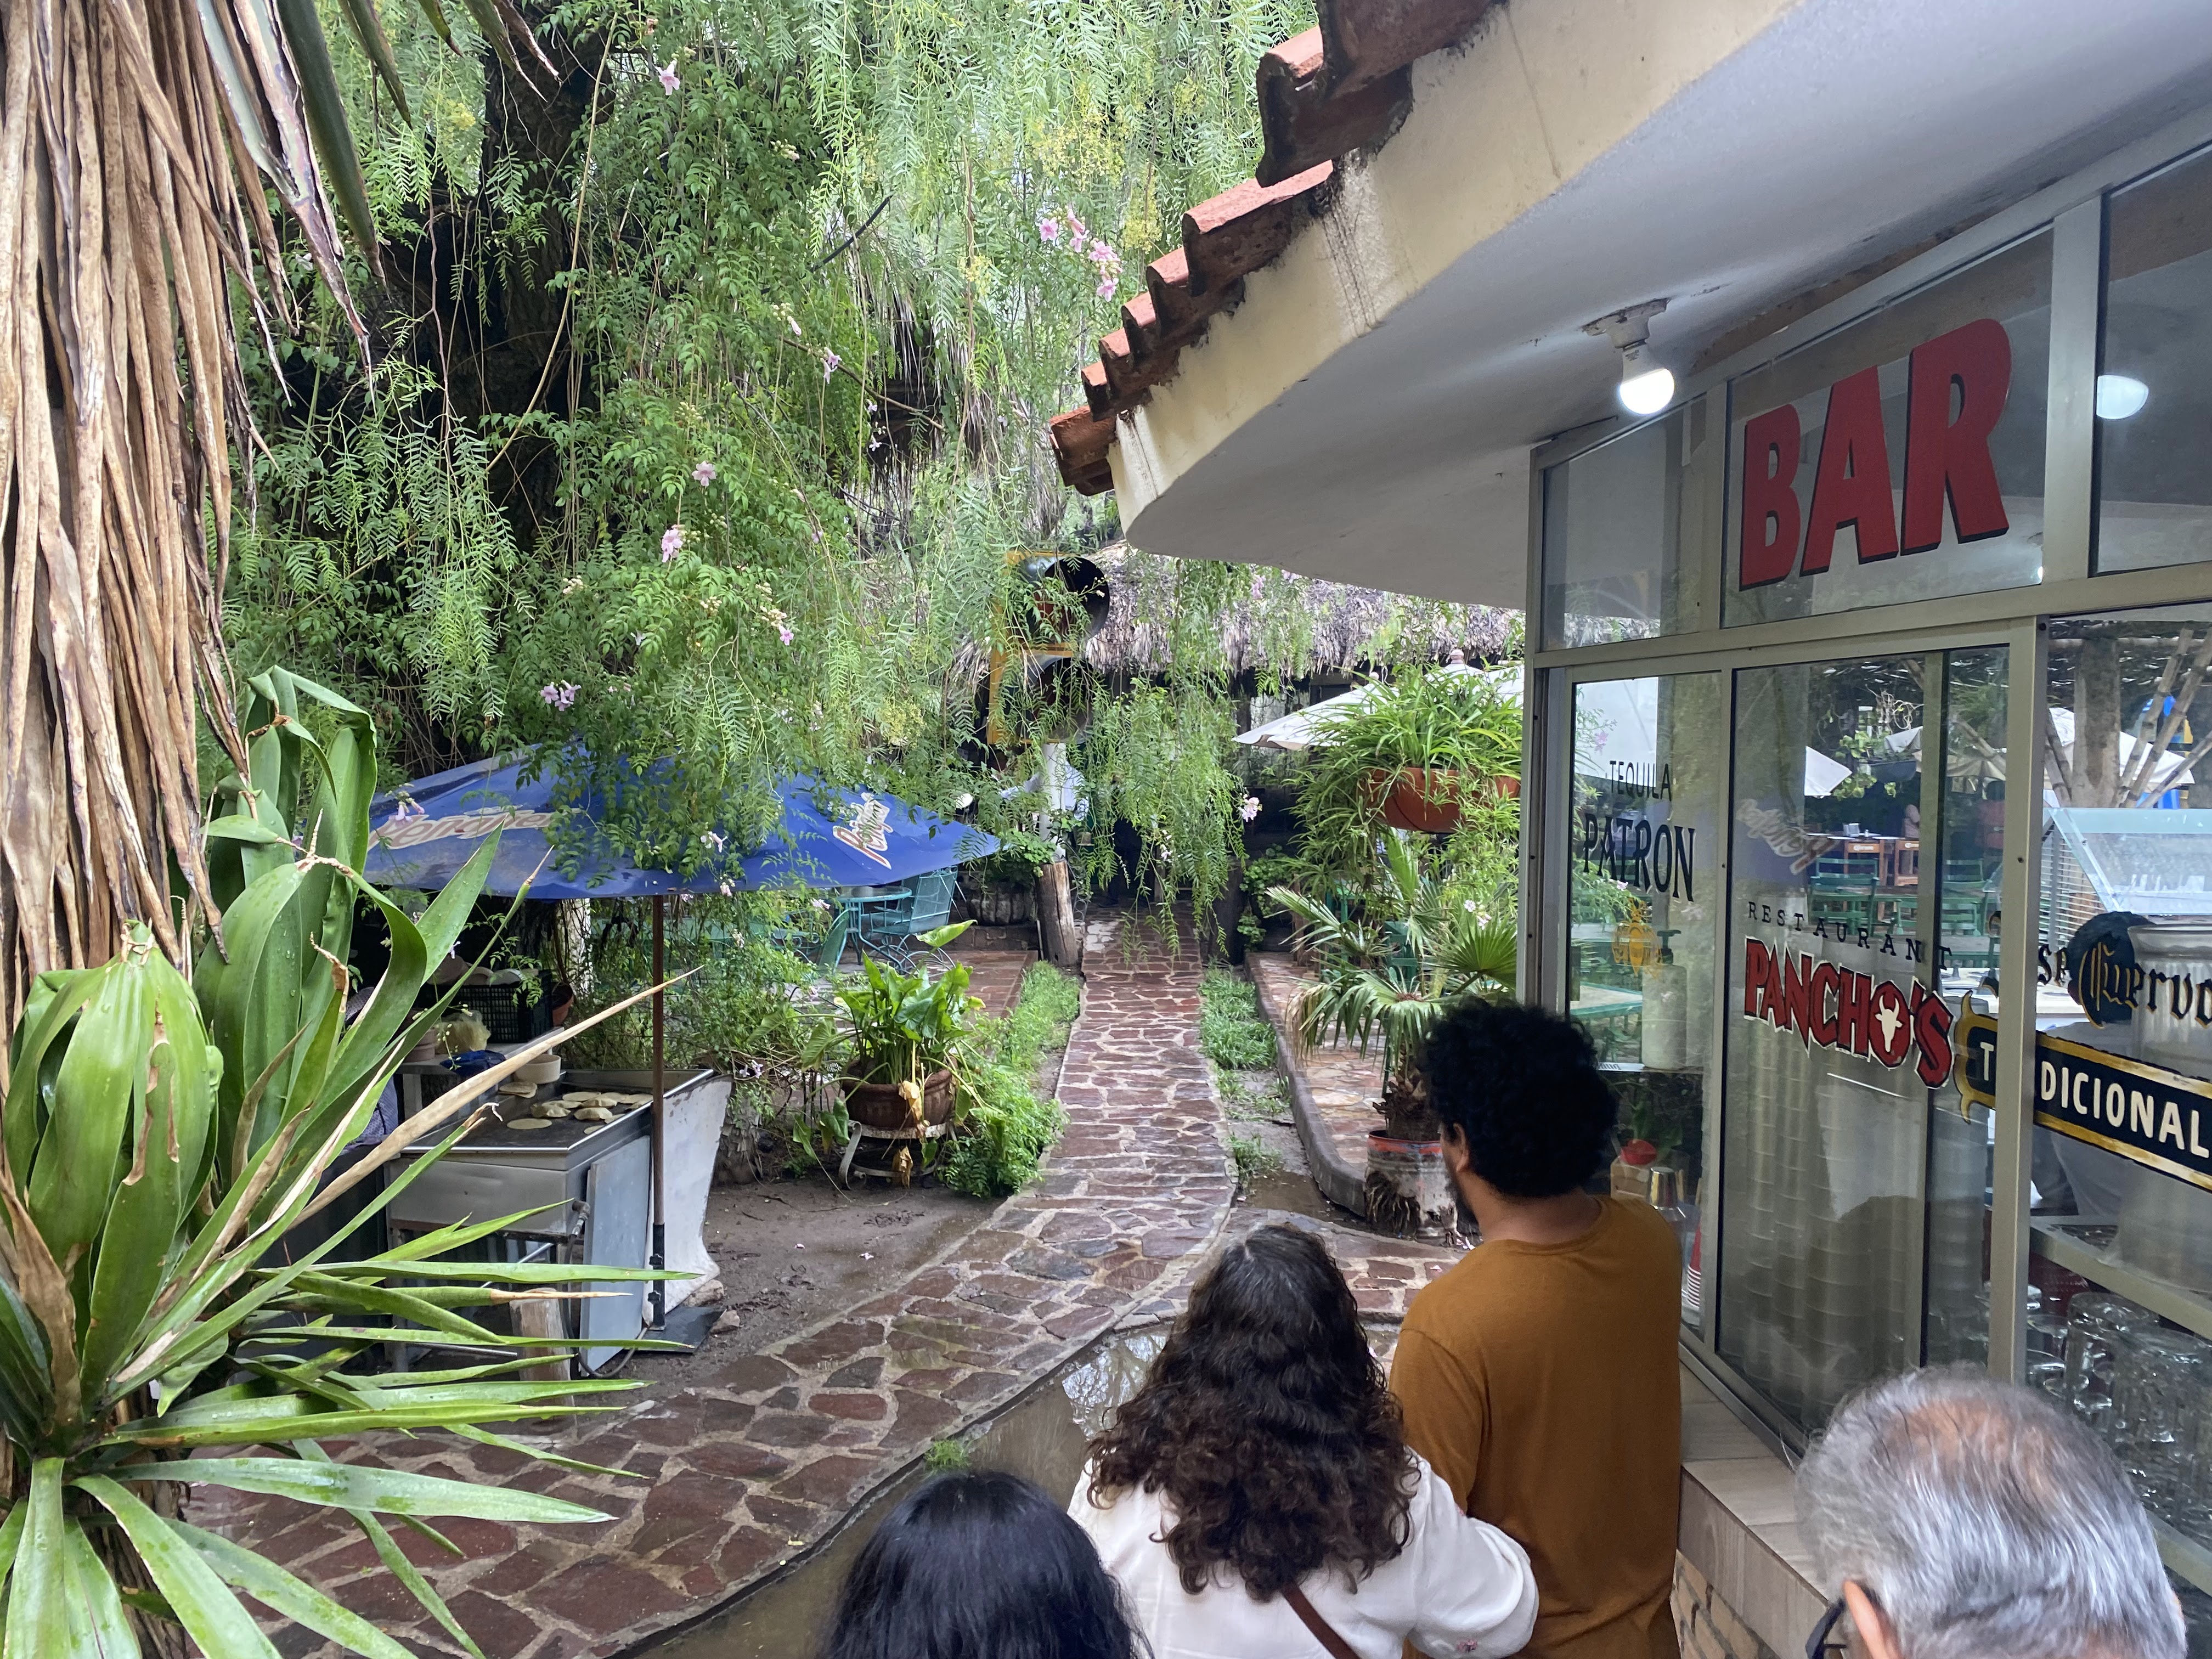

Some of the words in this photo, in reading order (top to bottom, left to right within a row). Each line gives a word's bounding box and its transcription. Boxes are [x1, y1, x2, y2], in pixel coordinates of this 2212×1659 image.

[1739, 318, 2012, 591] BAR
[1609, 760, 1672, 802] TEQUILA
[1748, 901, 1953, 971] RESTAURANT
[1743, 936, 1955, 1090] PANCHO'S
[1980, 1042, 2210, 1159] TDICIONAL
